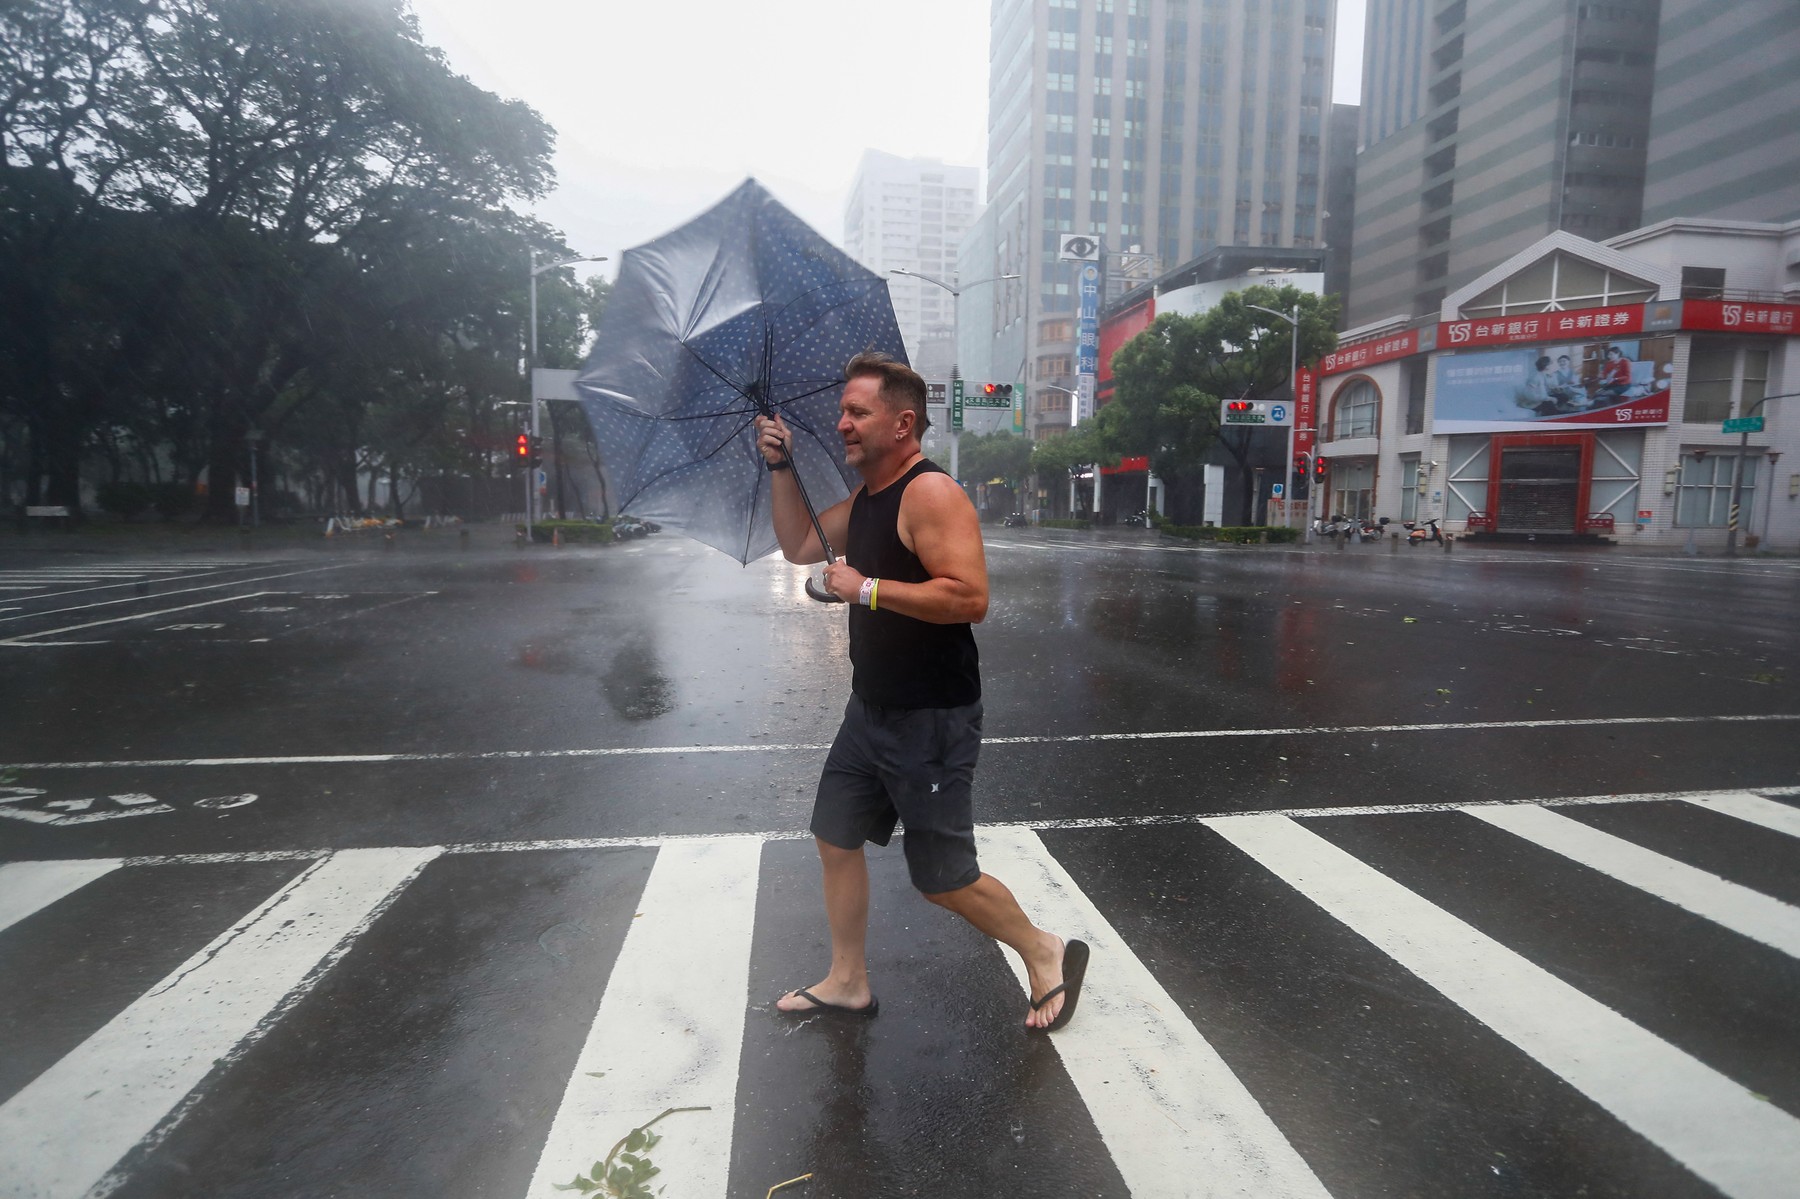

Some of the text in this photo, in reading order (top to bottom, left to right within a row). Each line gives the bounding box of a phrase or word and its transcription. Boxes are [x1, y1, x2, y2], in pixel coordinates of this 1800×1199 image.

[1081, 284, 1097, 370] 中山眼科
[1475, 321, 1539, 337] 台新銀行
[1559, 312, 1630, 330] 台新證券
[1745, 310, 1793, 324] 台新銀行
[1337, 349, 1367, 365] 台新銀行
[1301, 374, 1311, 413] 台新銀行
